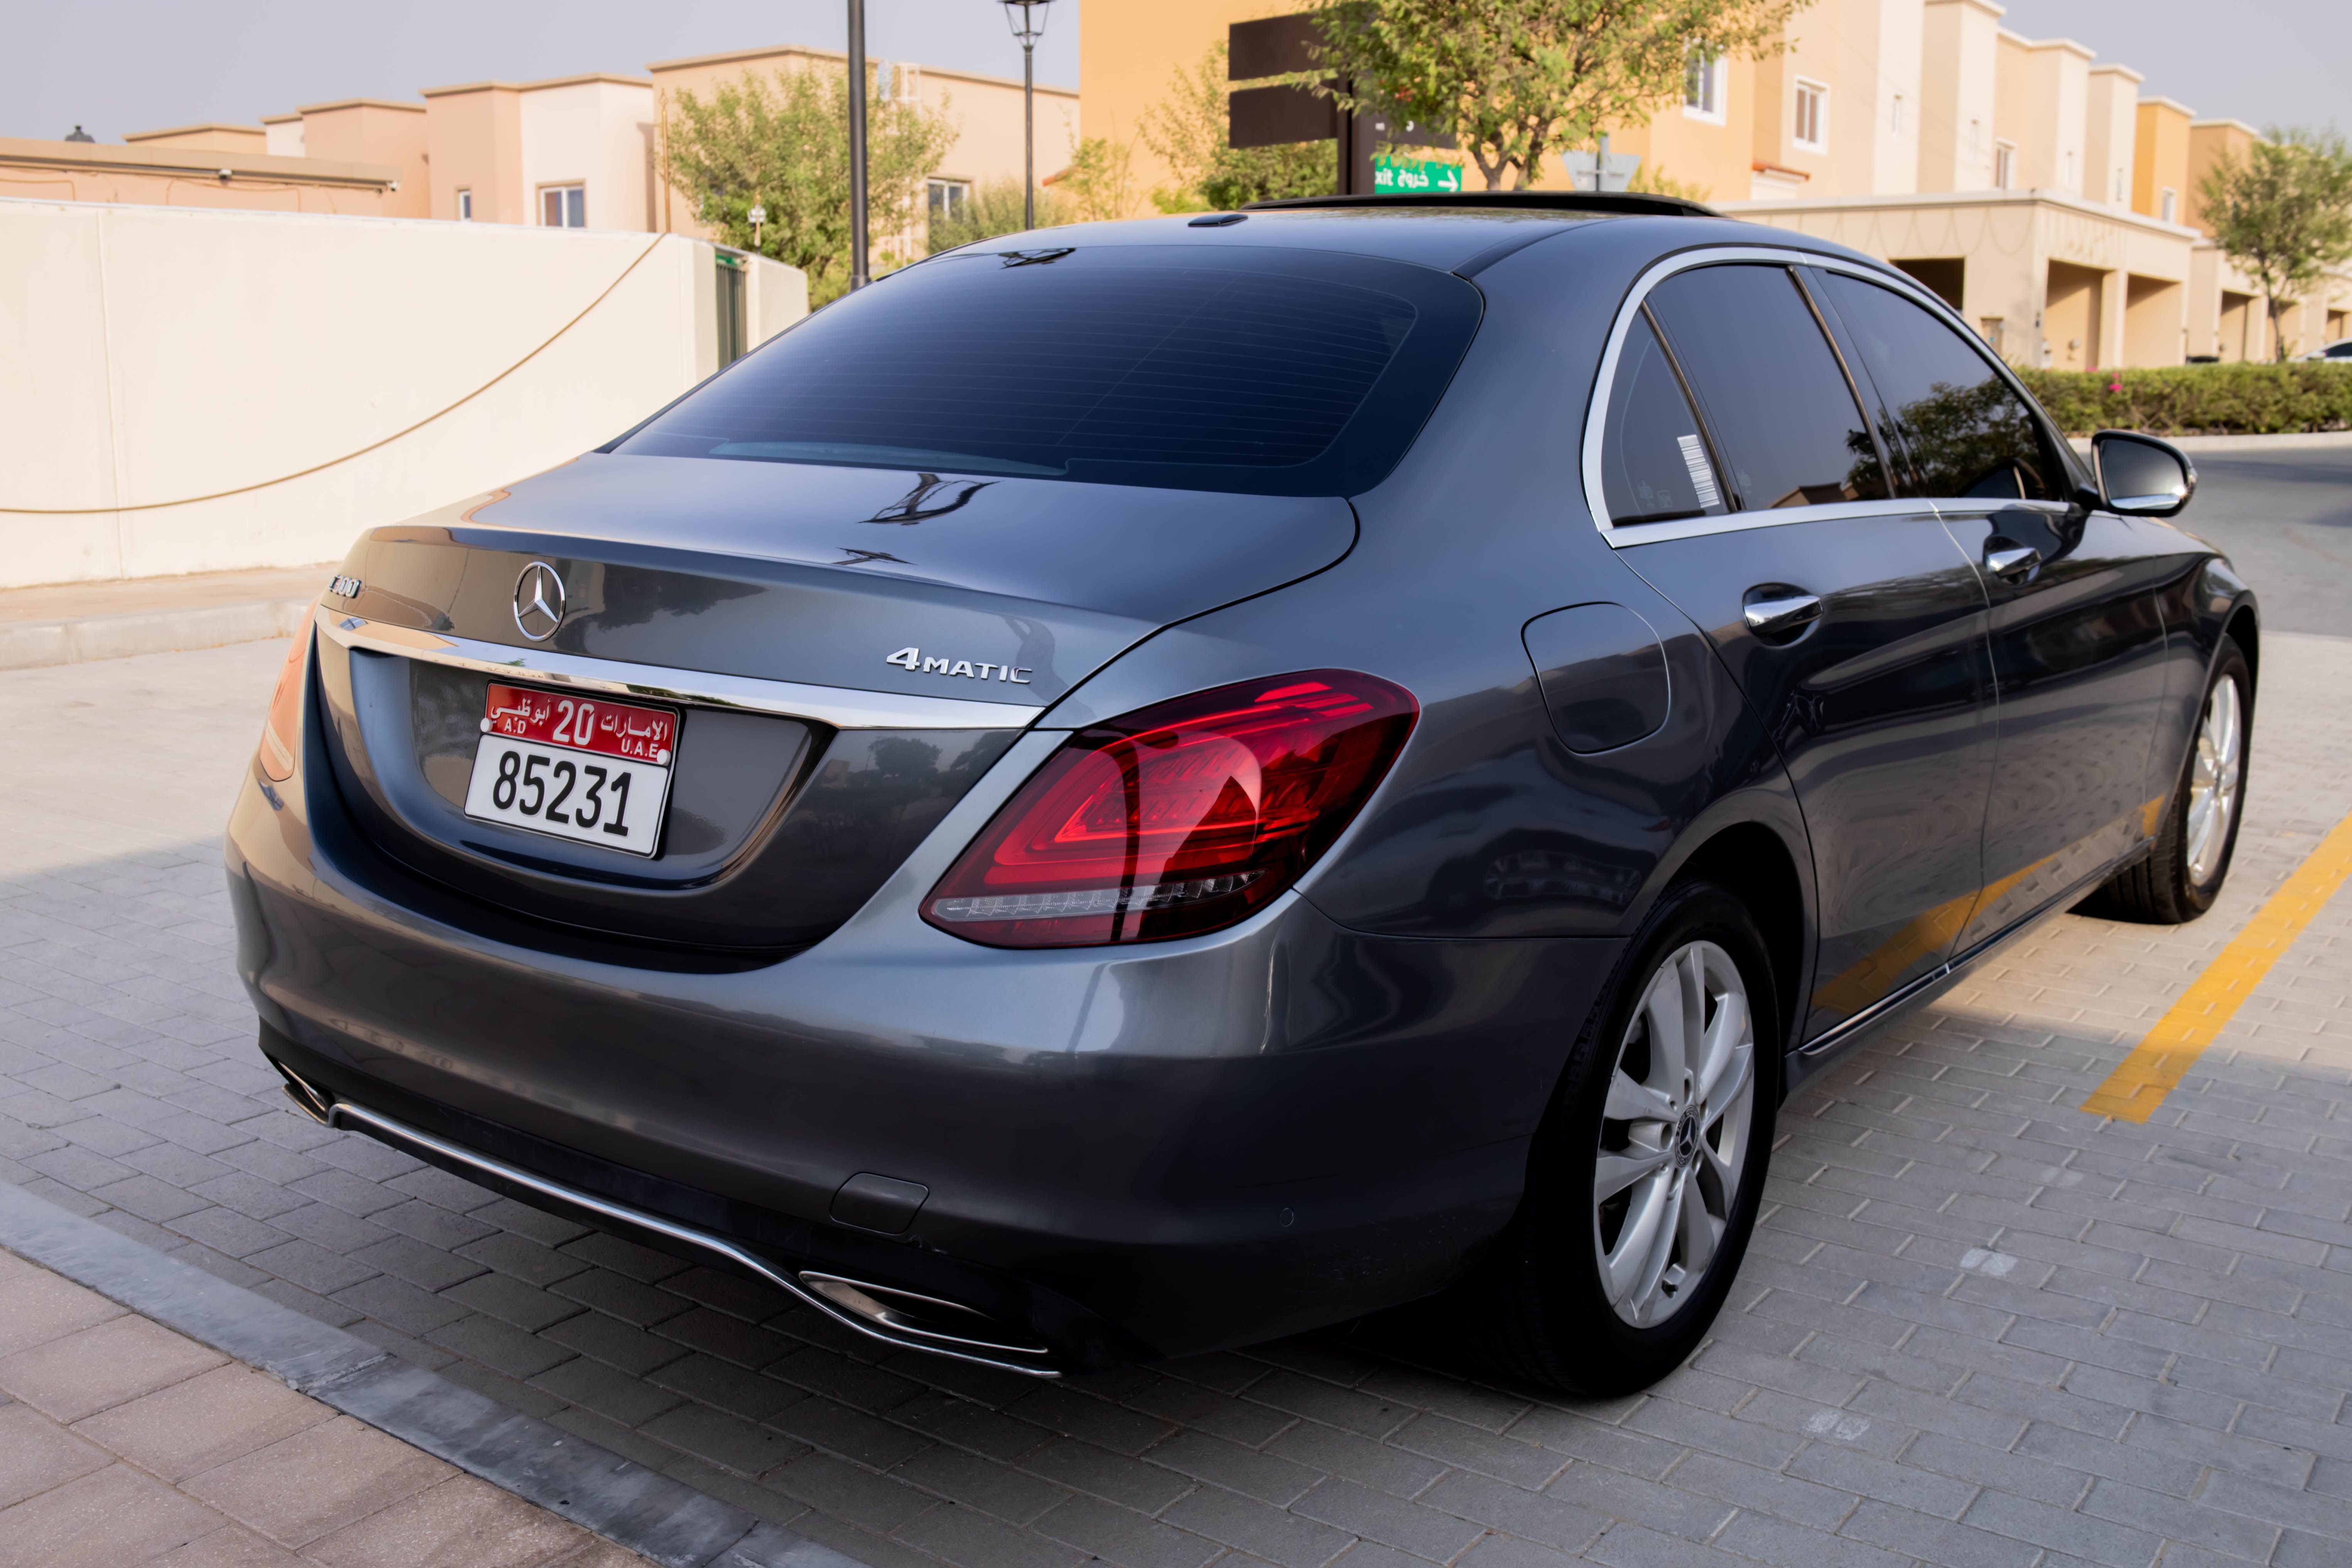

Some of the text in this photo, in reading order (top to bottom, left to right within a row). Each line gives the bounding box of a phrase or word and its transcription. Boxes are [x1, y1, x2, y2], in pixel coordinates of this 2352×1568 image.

[1375, 168, 1393, 186] xit
[886, 647, 1033, 684] 4MATIC
[553, 700, 595, 746] 20
[492, 751, 632, 837] 85231
